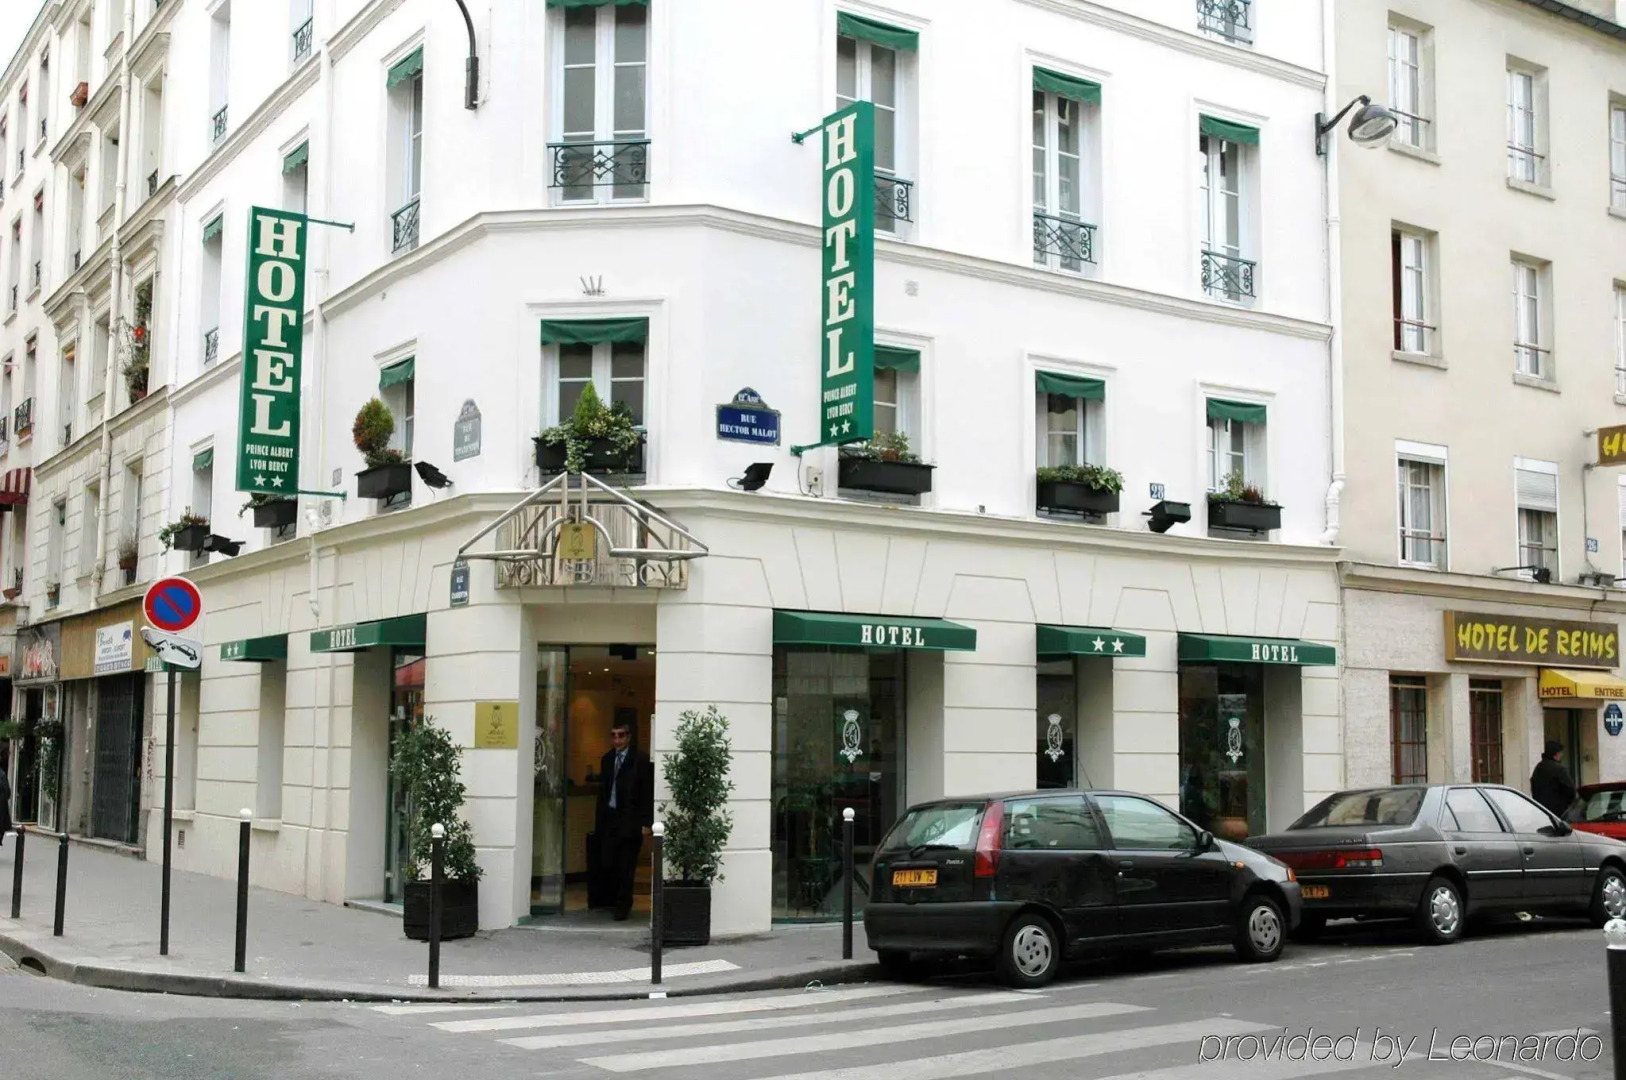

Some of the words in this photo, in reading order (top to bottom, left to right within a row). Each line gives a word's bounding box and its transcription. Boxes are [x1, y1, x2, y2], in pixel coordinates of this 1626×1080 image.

[825, 112, 857, 378] HOTEL
[250, 214, 302, 437] HOTEL
[740, 414, 757, 424] RUE
[720, 424, 750, 435] HECTOR
[751, 428, 777, 438] MALOT
[246, 444, 269, 456] PRINCE
[270, 446, 294, 459] ALBERT
[250, 459, 267, 470] LYON
[268, 461, 289, 472] BERCY
[1151, 484, 1164, 499] 28
[330, 628, 356, 648] HOTEL
[861, 624, 925, 646] HOTEL
[1458, 622, 1519, 653] HOTEL
[1525, 627, 1549, 655] DE
[1556, 629, 1616, 659] REIMS
[1251, 644, 1298, 662] HOTEL
[1542, 686, 1572, 696] HOTEL
[1594, 687, 1624, 698] ENTREE
[926, 871, 935, 883] 75
